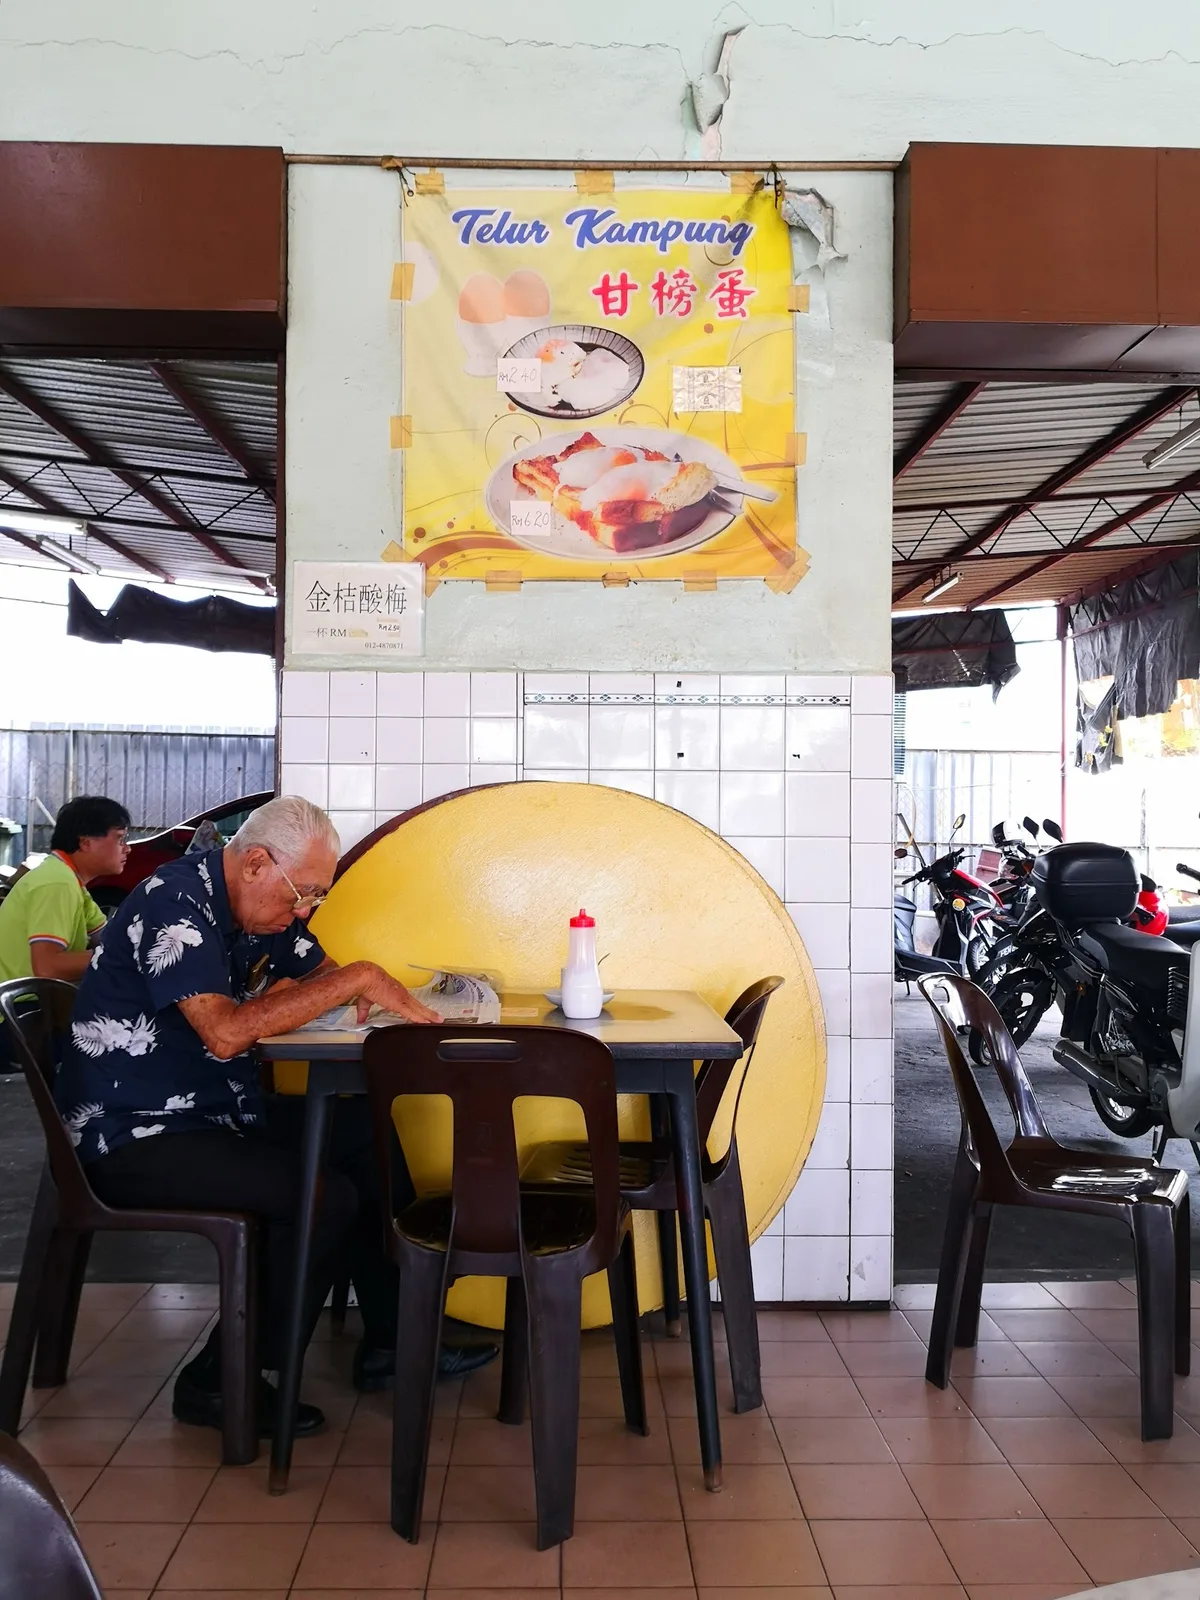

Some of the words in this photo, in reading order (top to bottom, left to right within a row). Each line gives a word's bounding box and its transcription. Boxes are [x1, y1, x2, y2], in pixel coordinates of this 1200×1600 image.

[452, 208, 549, 244] Telur
[565, 208, 753, 256] Kampung
[592, 269, 756, 317] 甘榜蛋
[304, 580, 408, 615] 金桔酸梅
[329, 628, 348, 638] RM
